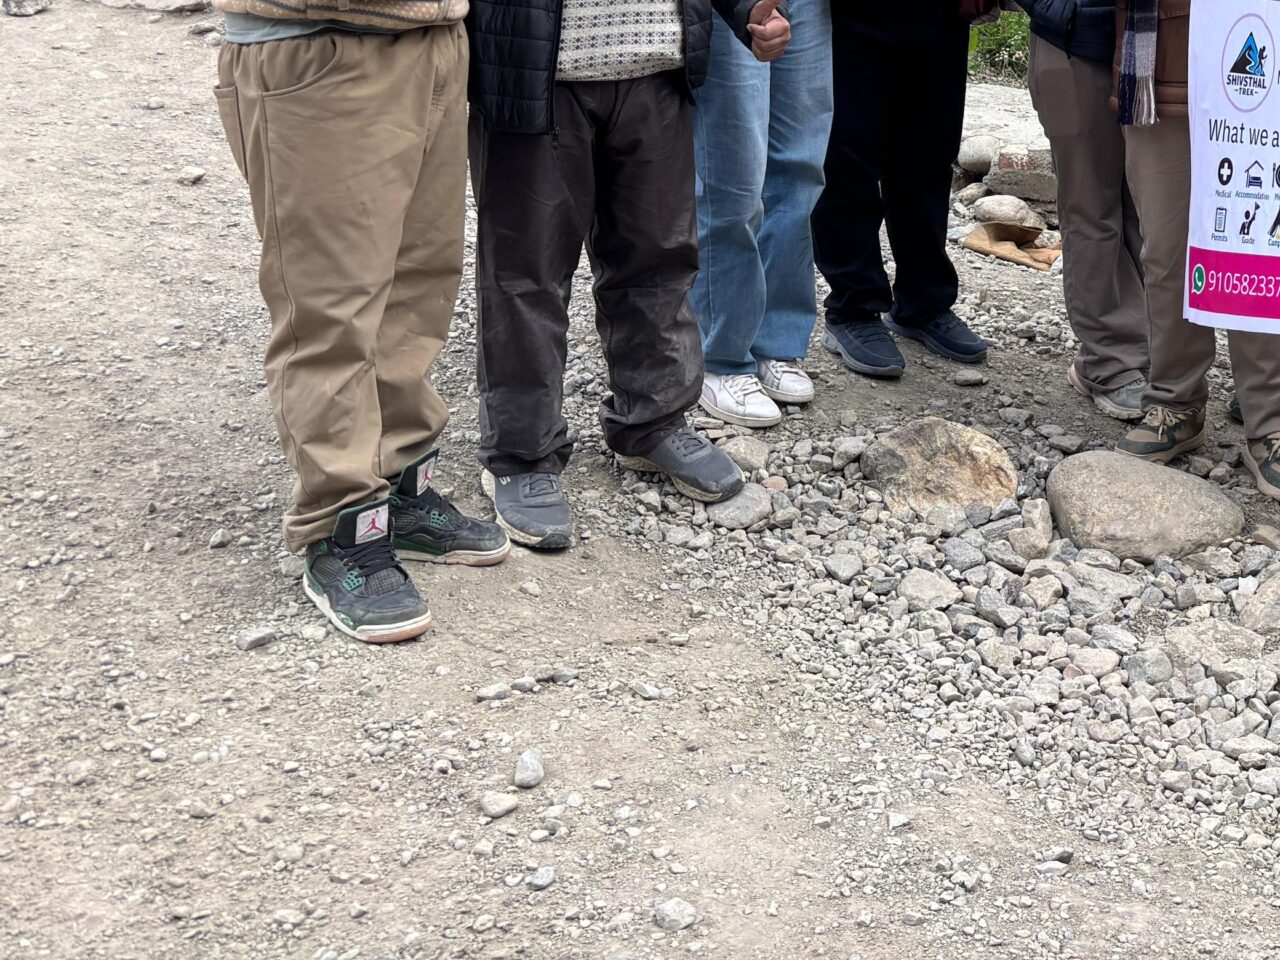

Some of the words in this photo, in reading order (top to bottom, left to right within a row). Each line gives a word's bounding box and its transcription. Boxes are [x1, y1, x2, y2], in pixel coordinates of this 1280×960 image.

[1226, 73, 1267, 89] SHIVSTHAL
[1208, 118, 1245, 144] What
[1249, 127, 1268, 146] we
[1215, 189, 1232, 198] Medical
